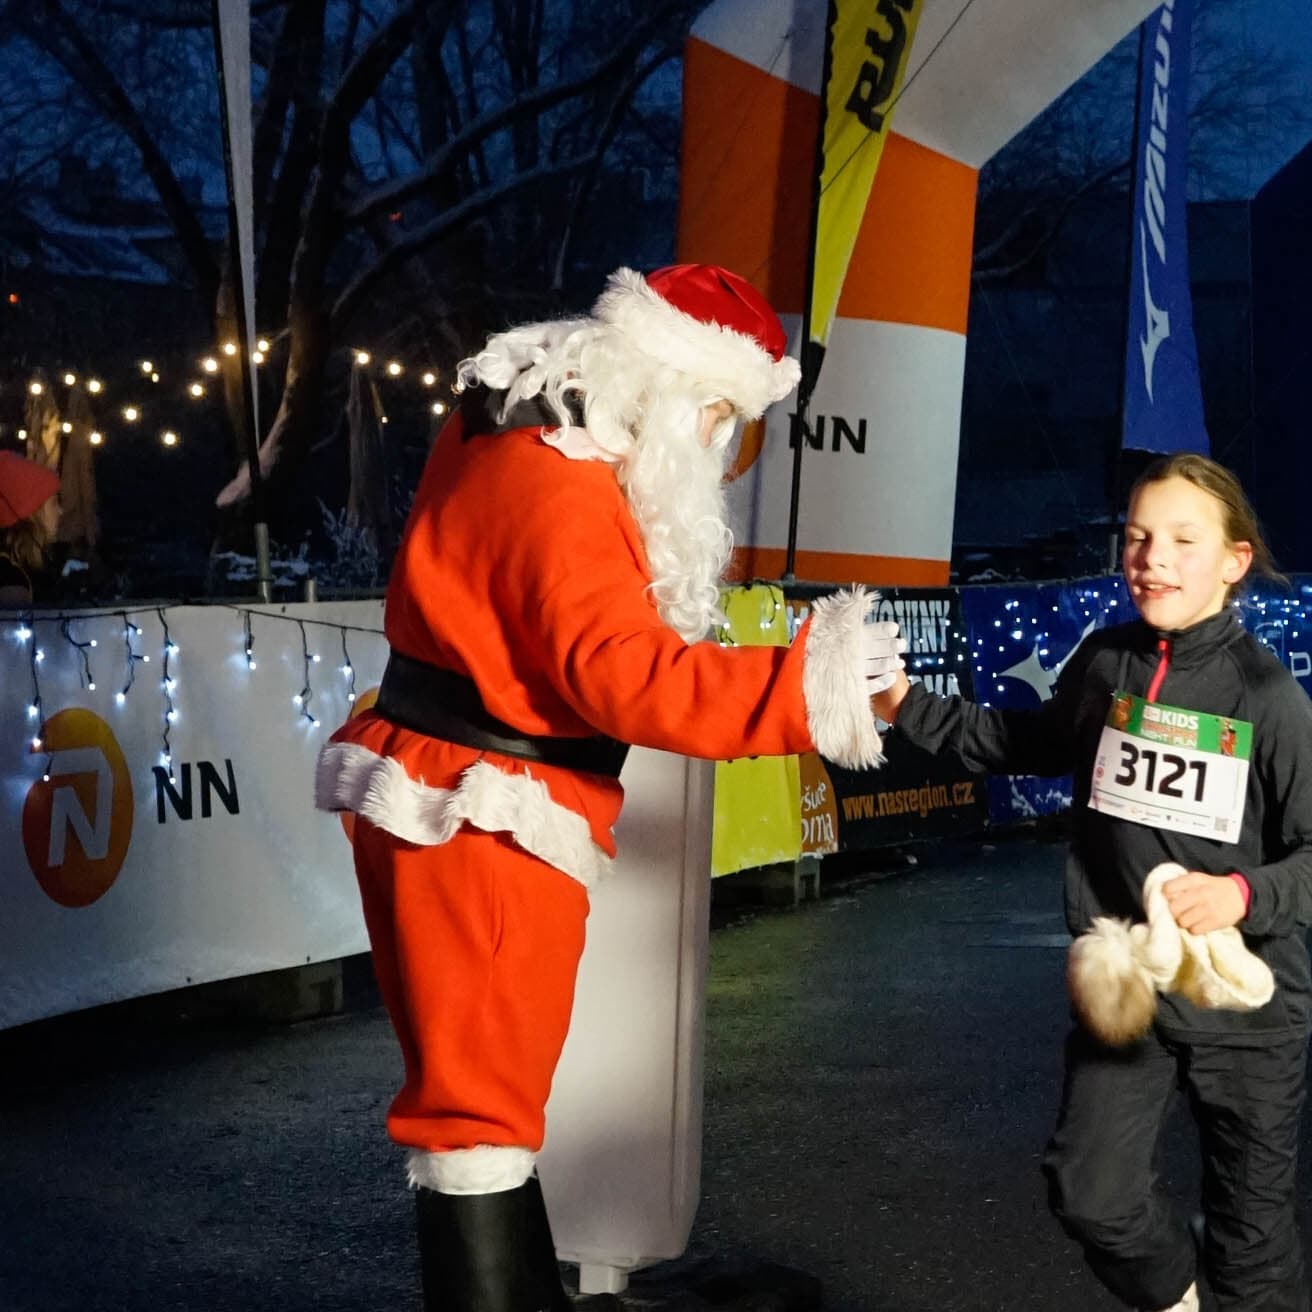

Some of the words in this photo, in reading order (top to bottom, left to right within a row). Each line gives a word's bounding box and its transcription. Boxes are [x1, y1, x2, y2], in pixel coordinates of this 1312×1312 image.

[789, 412, 867, 454] NN
[1160, 710, 1199, 730] KIDS
[152, 758, 240, 825] NN
[1114, 740, 1208, 803] 3121
